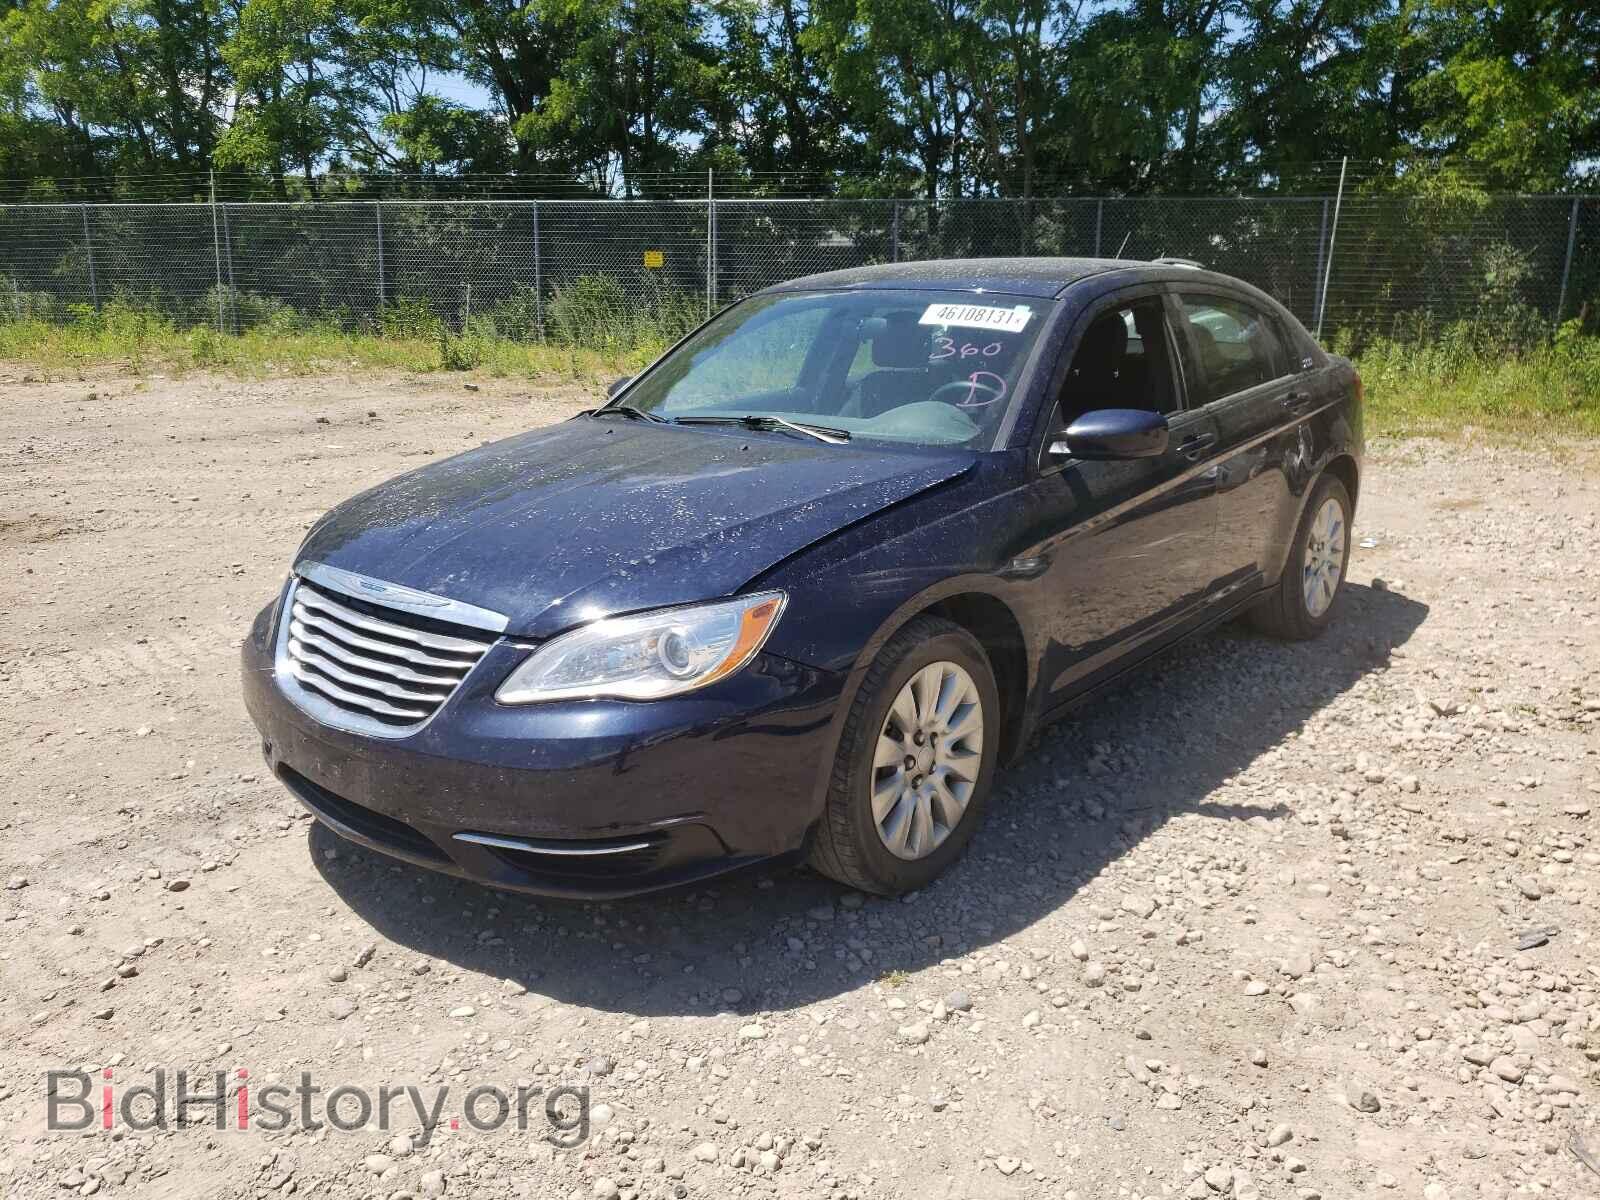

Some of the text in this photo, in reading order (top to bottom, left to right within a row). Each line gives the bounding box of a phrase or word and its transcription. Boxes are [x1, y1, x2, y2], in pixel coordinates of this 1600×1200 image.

[937, 306, 1014, 324] 46108131
[929, 337, 1001, 359] 360
[956, 371, 1007, 407] D
